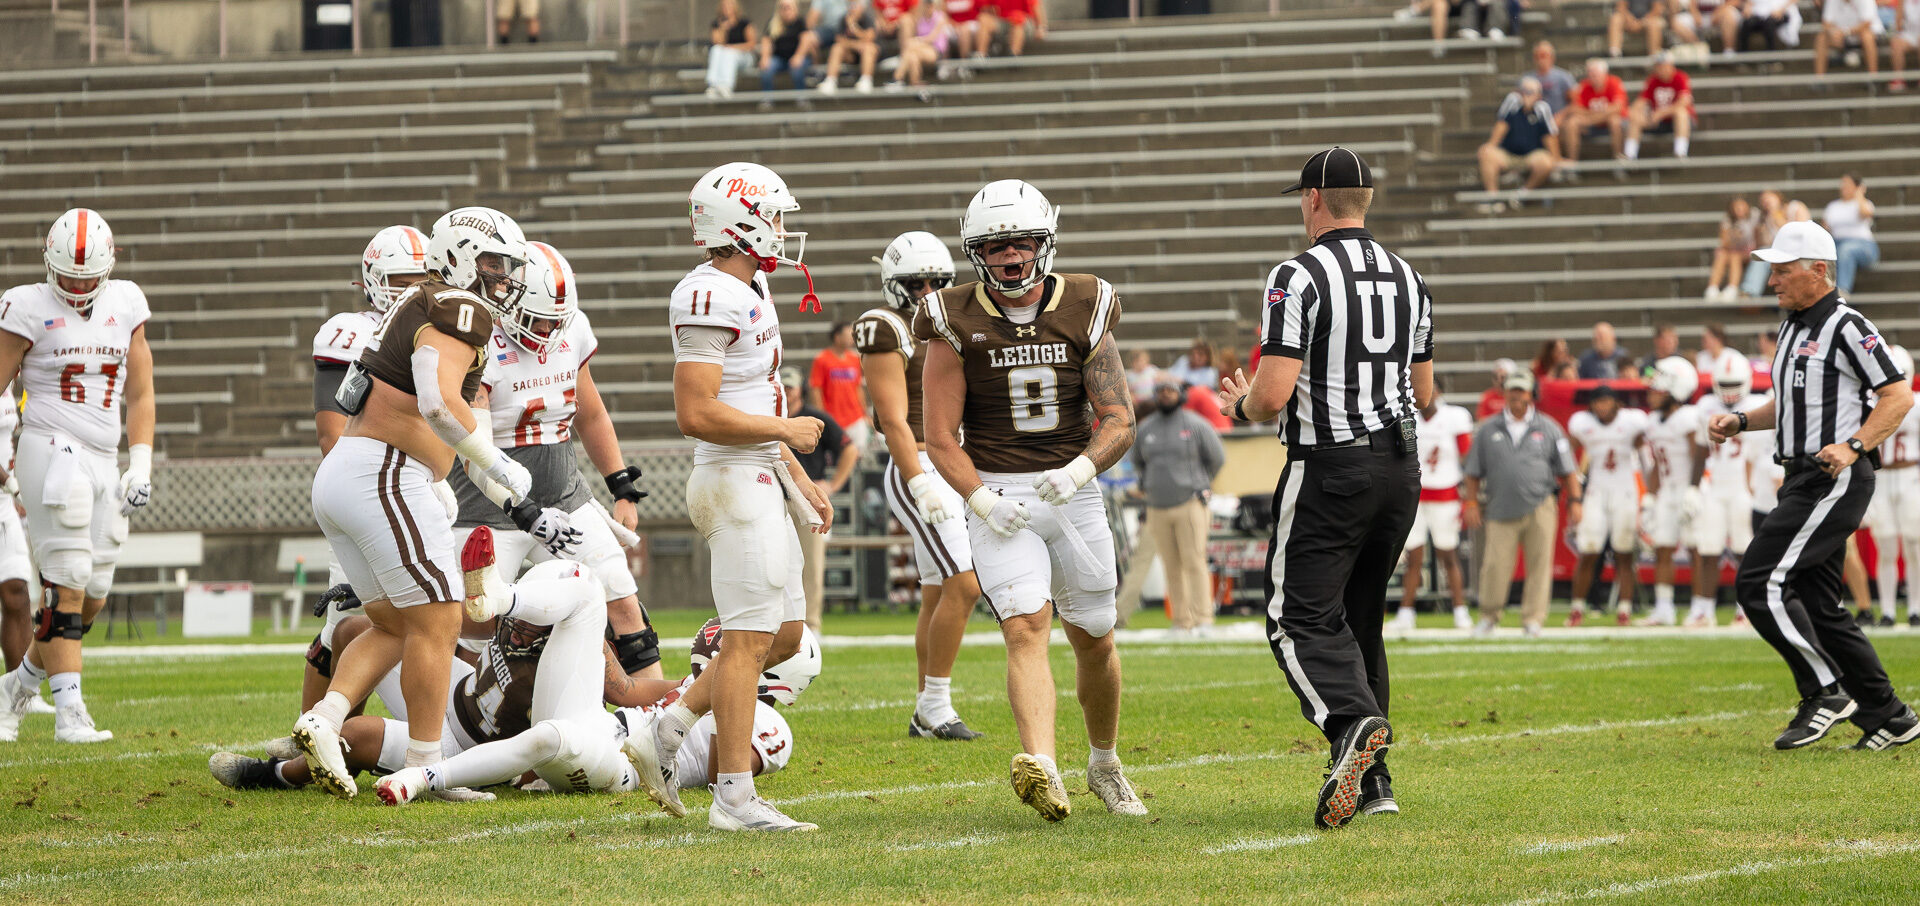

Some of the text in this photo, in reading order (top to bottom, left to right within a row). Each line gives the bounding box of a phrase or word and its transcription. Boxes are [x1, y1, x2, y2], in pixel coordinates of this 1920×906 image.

[726, 177, 768, 198] Pios
[451, 216, 495, 239] LEHIGH
[690, 290, 712, 316] 11
[456, 303, 475, 333] 0
[1355, 281, 1398, 354] U
[328, 327, 357, 350] 73
[493, 334, 507, 349] C
[855, 321, 878, 348] 37
[53, 347, 93, 357] SACRED
[988, 343, 1068, 368] LEHIGH
[59, 363, 120, 409] 67
[512, 376, 551, 393] SACRED
[1793, 369, 1805, 388] R
[1008, 364, 1060, 433] 8
[758, 726, 787, 757] 23
